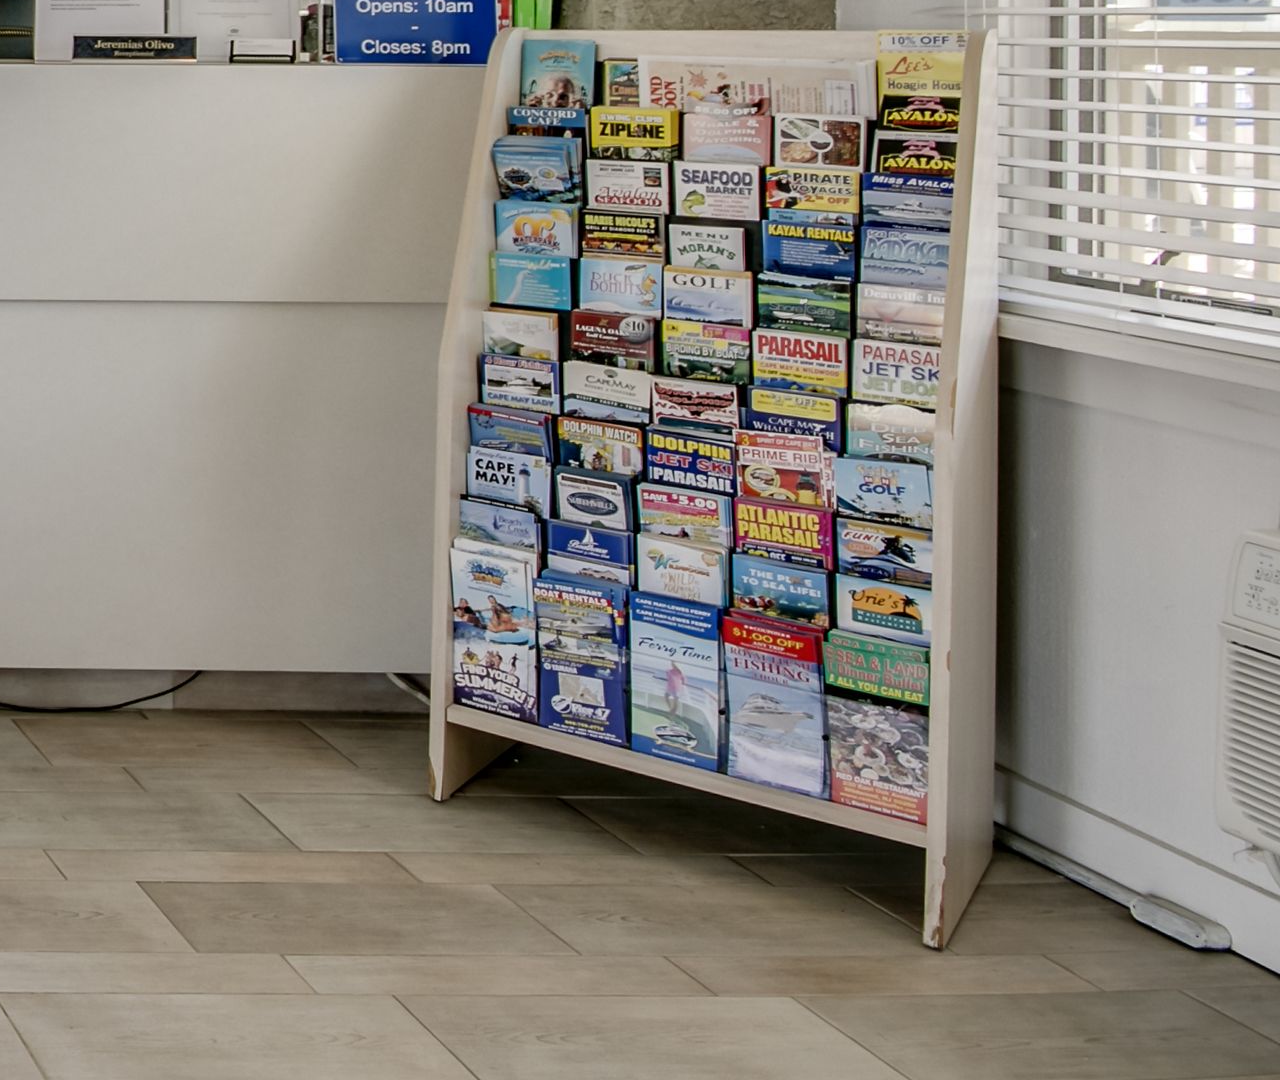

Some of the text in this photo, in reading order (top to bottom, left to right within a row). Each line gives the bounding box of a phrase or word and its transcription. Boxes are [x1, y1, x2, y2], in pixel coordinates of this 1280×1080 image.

[425, 0, 474, 13] 10am
[94, 39, 175, 51] Jeremias Olivo
[361, 39, 471, 57] Closes: 8pm
[921, 36, 950, 45] OFF
[887, 78, 928, 91] Hoagie
[513, 108, 577, 119] CONCORD
[599, 122, 665, 139] ZIPLINE
[681, 168, 753, 187] SEAFOOD
[792, 172, 851, 185] PIRATE
[705, 186, 753, 196] MARKET
[791, 184, 853, 195] VOYAGES
[597, 197, 660, 206] SEAFOOD
[827, 196, 850, 205] OFF
[615, 216, 655, 229] NICOLE'S
[681, 230, 729, 240] MENU
[768, 224, 854, 242] KAYAK RENTALS
[677, 242, 736, 261] MORAN'S
[592, 271, 632, 281] DUCK
[673, 273, 736, 290] GOLF
[590, 280, 644, 295] DONUTS
[864, 288, 923, 302] Deauville
[576, 324, 606, 334] LAGUNA
[666, 343, 700, 355] BIRDING
[702, 346, 713, 356] BY
[757, 334, 842, 364] PARASAIL
[862, 362, 904, 378] JET
[862, 377, 898, 392] JET
[488, 392, 554, 407] CAPE MAY LADY
[753, 421, 793, 433] WHALE
[768, 416, 794, 427] CAPE
[563, 420, 603, 437] DOLPHIN
[604, 426, 637, 443] WATCH
[882, 433, 920, 444] SEA
[652, 434, 730, 461] DOLPHIN
[757, 437, 775, 445] SPIRIT
[776, 438, 784, 446] OF
[785, 439, 802, 447] CAPE
[742, 448, 818, 463] PRIME RIB
[475, 458, 515, 475] CAPE
[652, 452, 733, 476] JET SKI
[475, 470, 516, 487] MAY!
[653, 467, 734, 493] PARASAIL
[859, 483, 906, 496] GOLF
[643, 492, 717, 510] SAVE $5.00
[738, 504, 820, 532] ATLANTIC
[739, 521, 821, 549] PARASAIL
[843, 530, 881, 542] FUN!
[748, 569, 774, 579] THE
[741, 576, 821, 598] TO SEA LIFE!
[534, 588, 608, 607] BOAT RENTALS
[848, 589, 899, 609] Urie's
[732, 627, 804, 649] $1.00 OFF
[639, 637, 712, 661] Ferry Time
[733, 657, 810, 682] FISHING
[834, 649, 927, 679] SEA & LAND
[488, 668, 518, 687] YOUR
[833, 665, 925, 691] Dinner Buffet
[455, 673, 527, 704] SUMMER!
[837, 675, 924, 703] ALL YOU CAN EAT
[836, 772, 926, 799] RED OAK RESTAURANT
